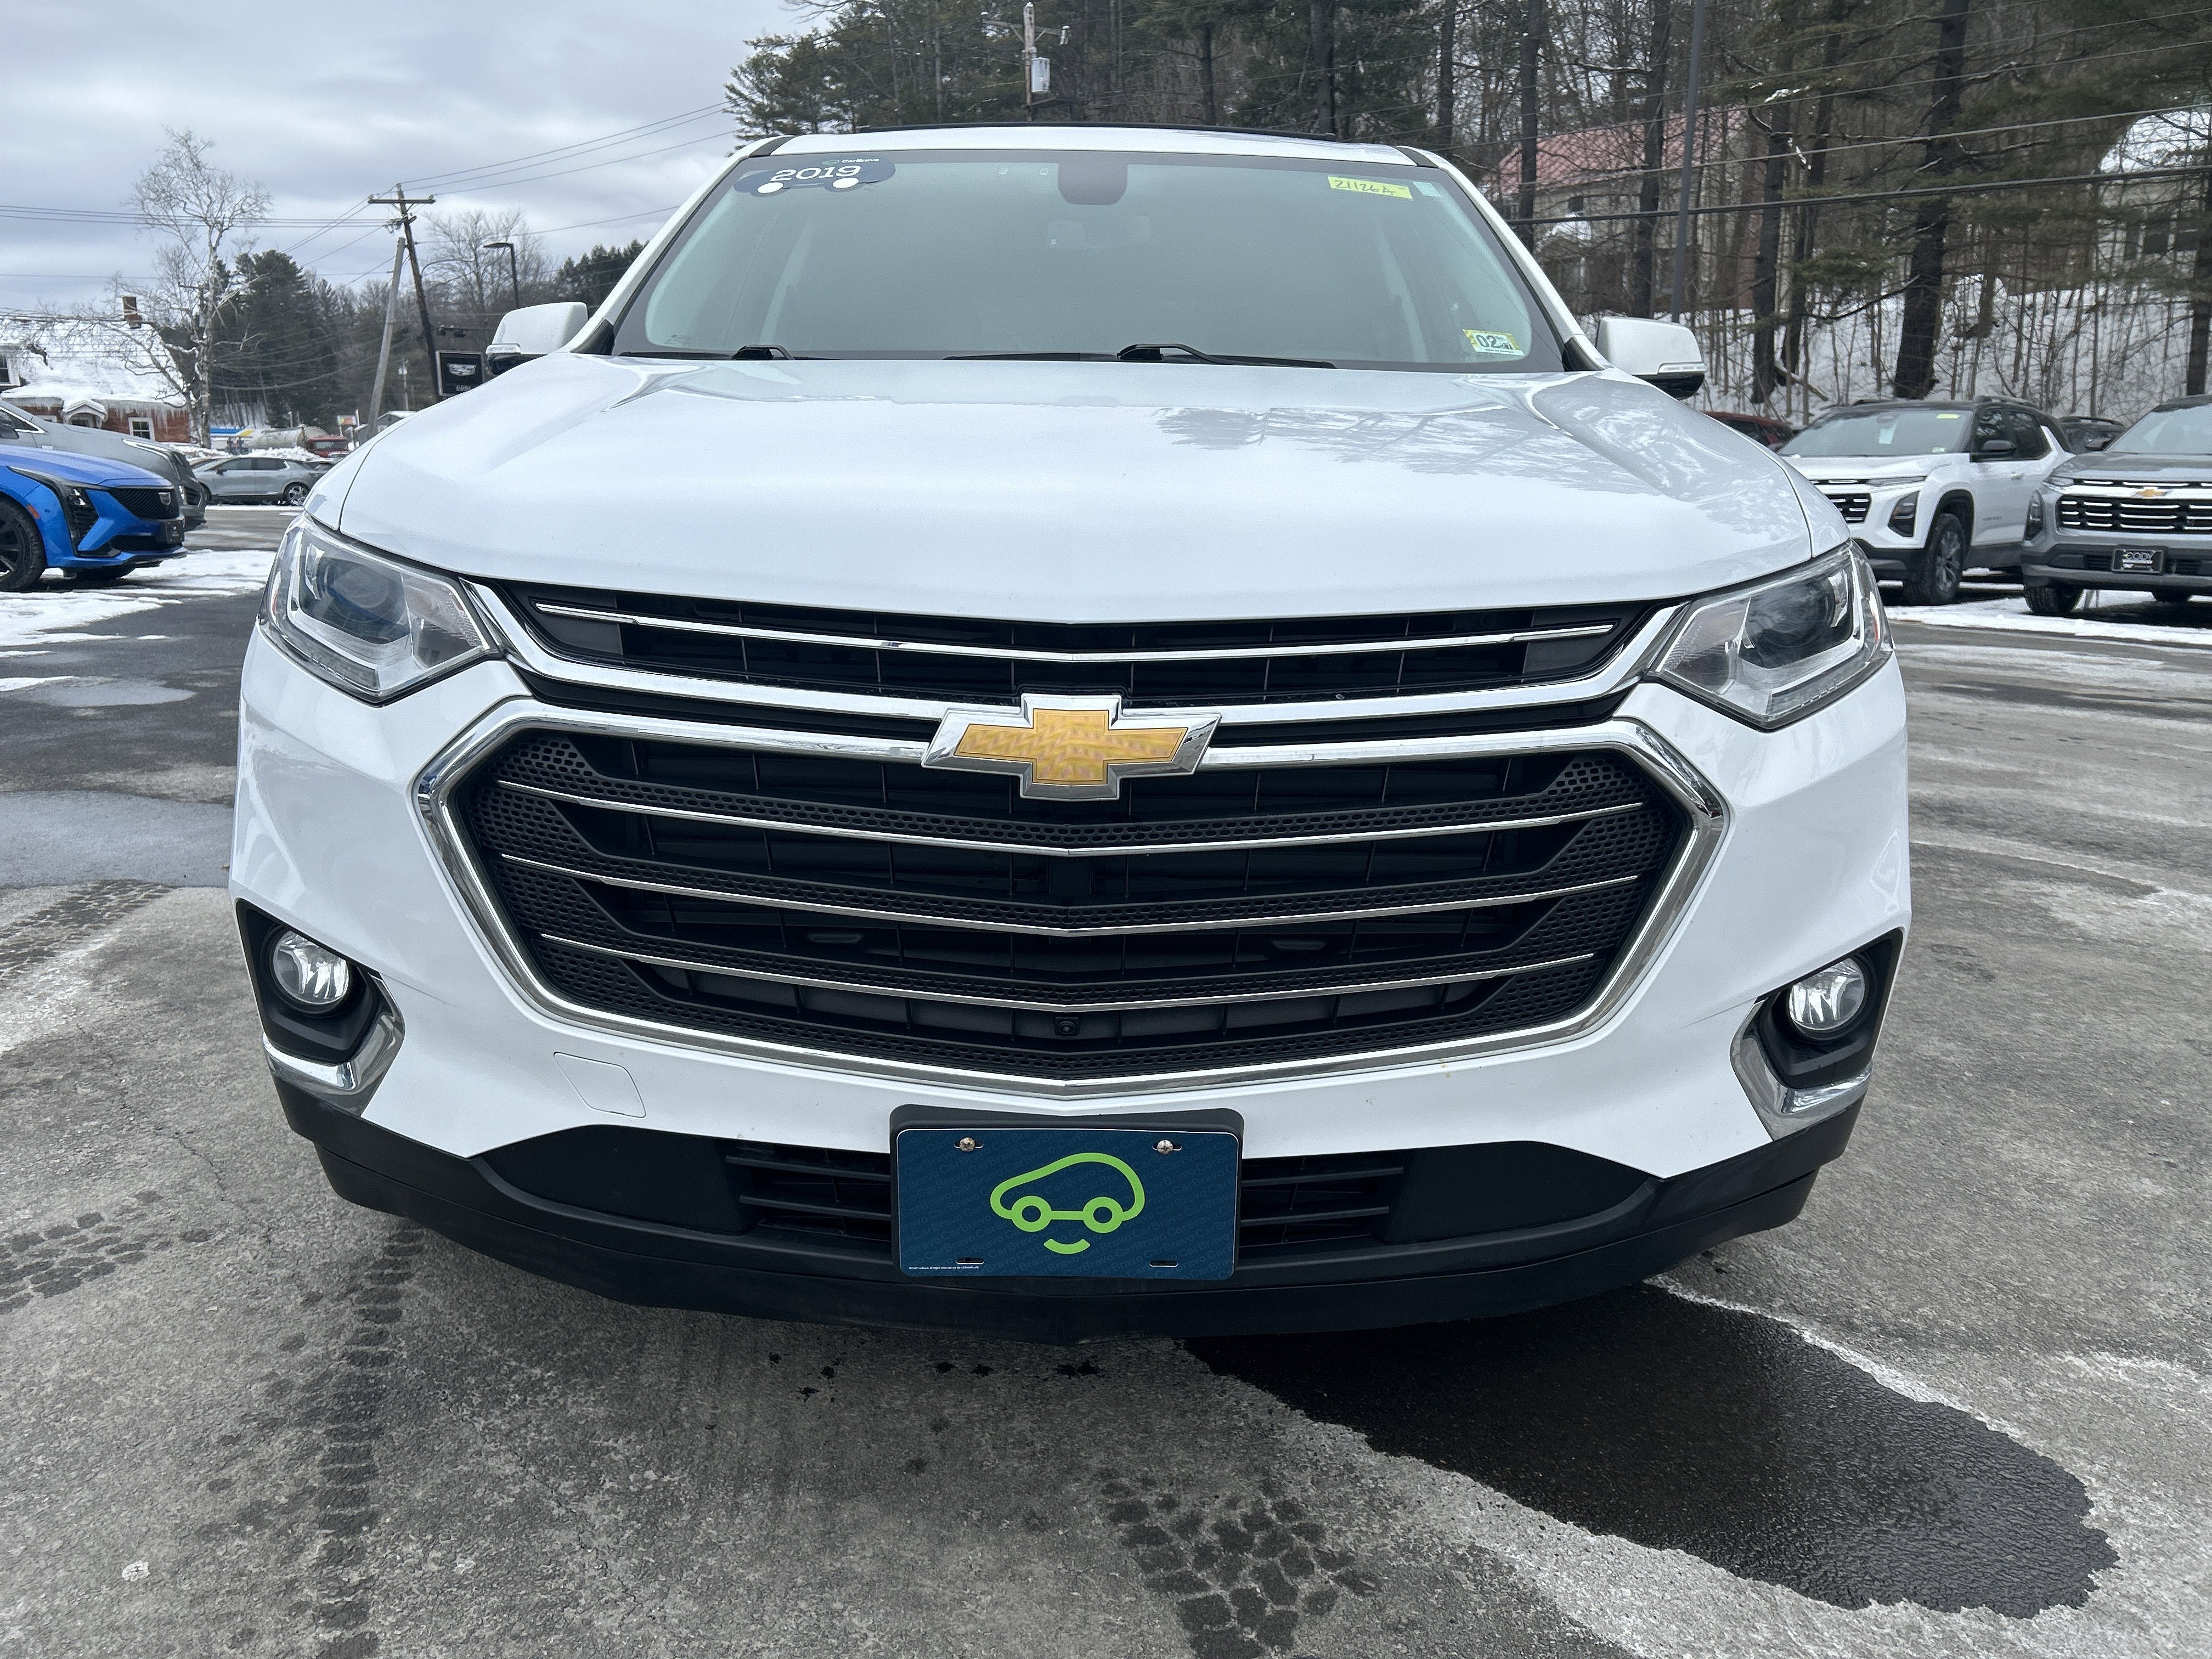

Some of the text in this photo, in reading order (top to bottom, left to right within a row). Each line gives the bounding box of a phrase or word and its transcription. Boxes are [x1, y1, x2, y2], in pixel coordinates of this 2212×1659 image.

[770, 165, 861, 182] 2019
[1334, 180, 1396, 195] 21126A
[1475, 335, 1502, 348] 02
